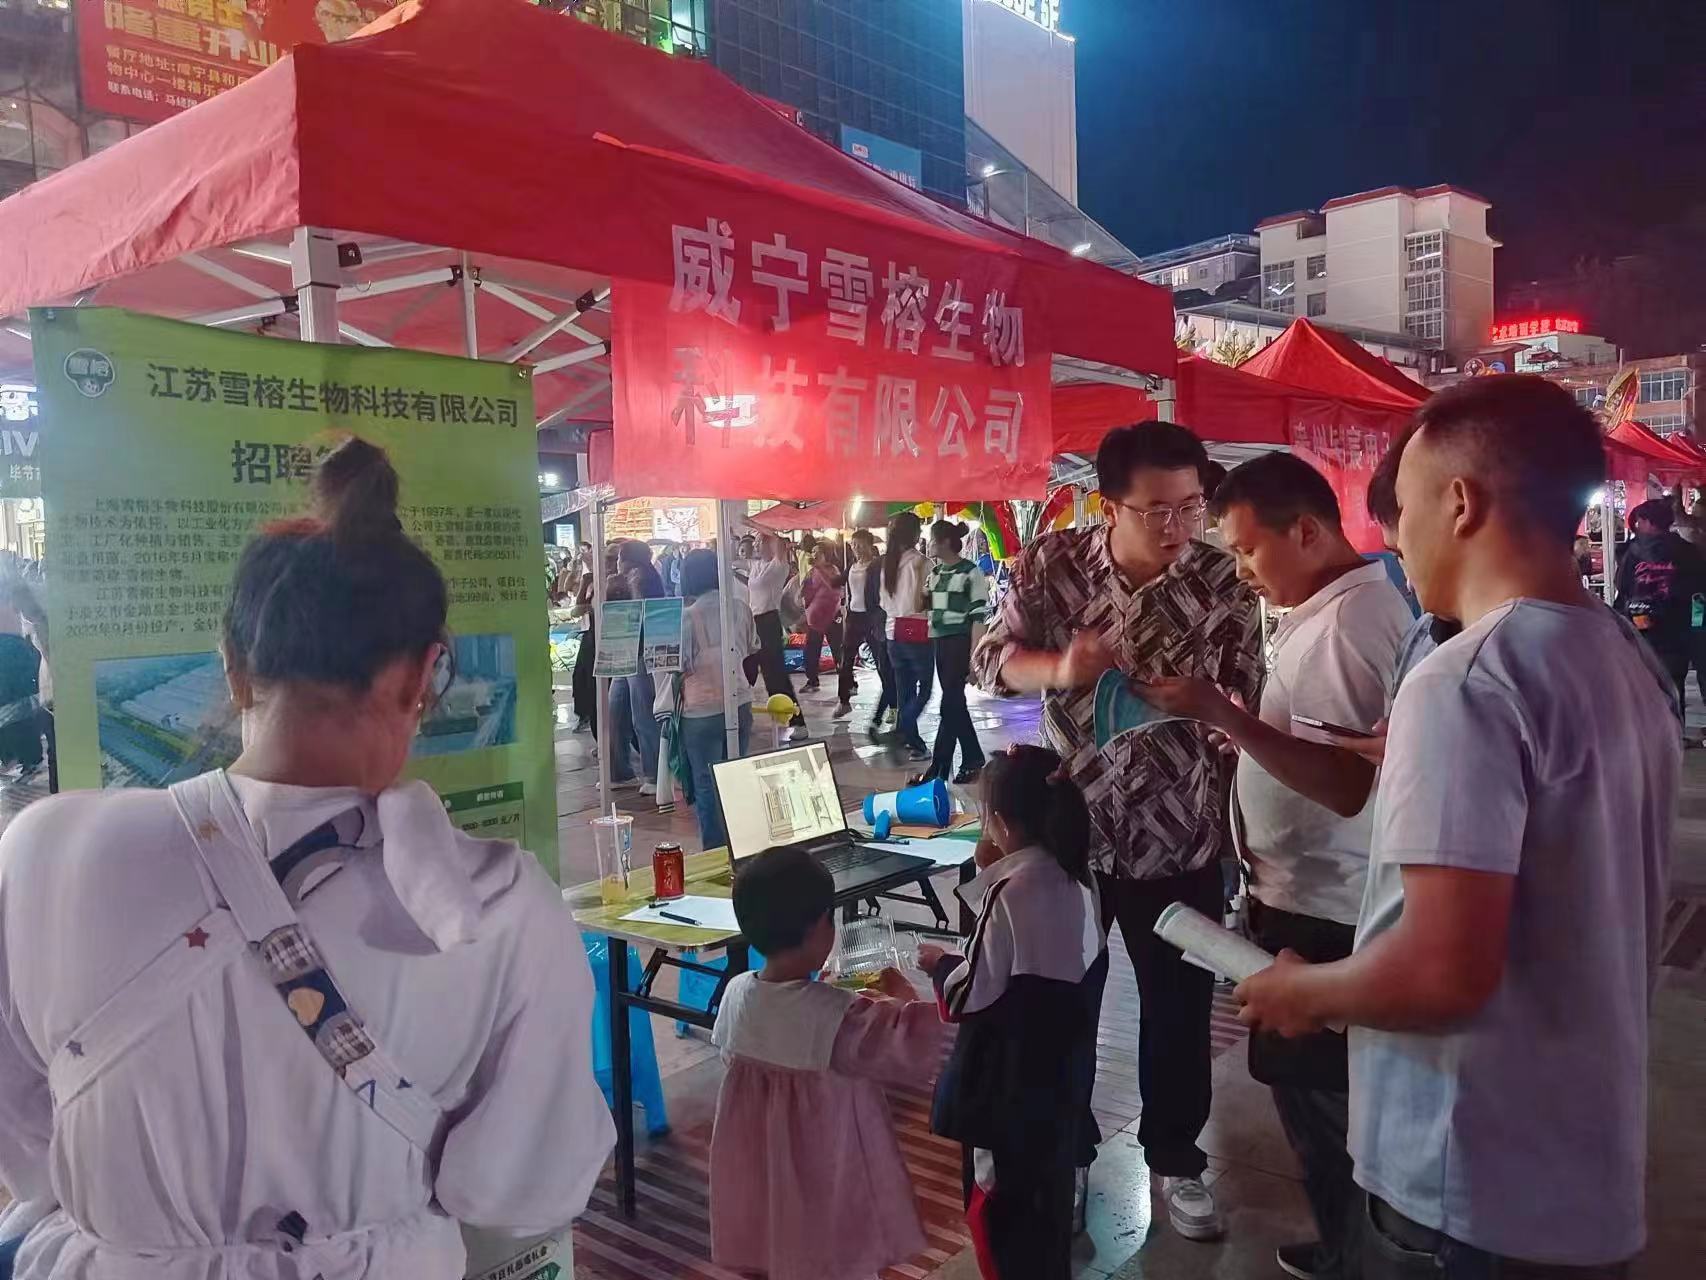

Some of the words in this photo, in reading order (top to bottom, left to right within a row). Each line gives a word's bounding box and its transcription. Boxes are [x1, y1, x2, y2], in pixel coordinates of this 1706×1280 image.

[669, 217, 1025, 368] 威宁雪榕生物
[147, 362, 518, 428] 江苏雪榕生物科技有限公司
[671, 346, 1024, 464] 科技有限公司
